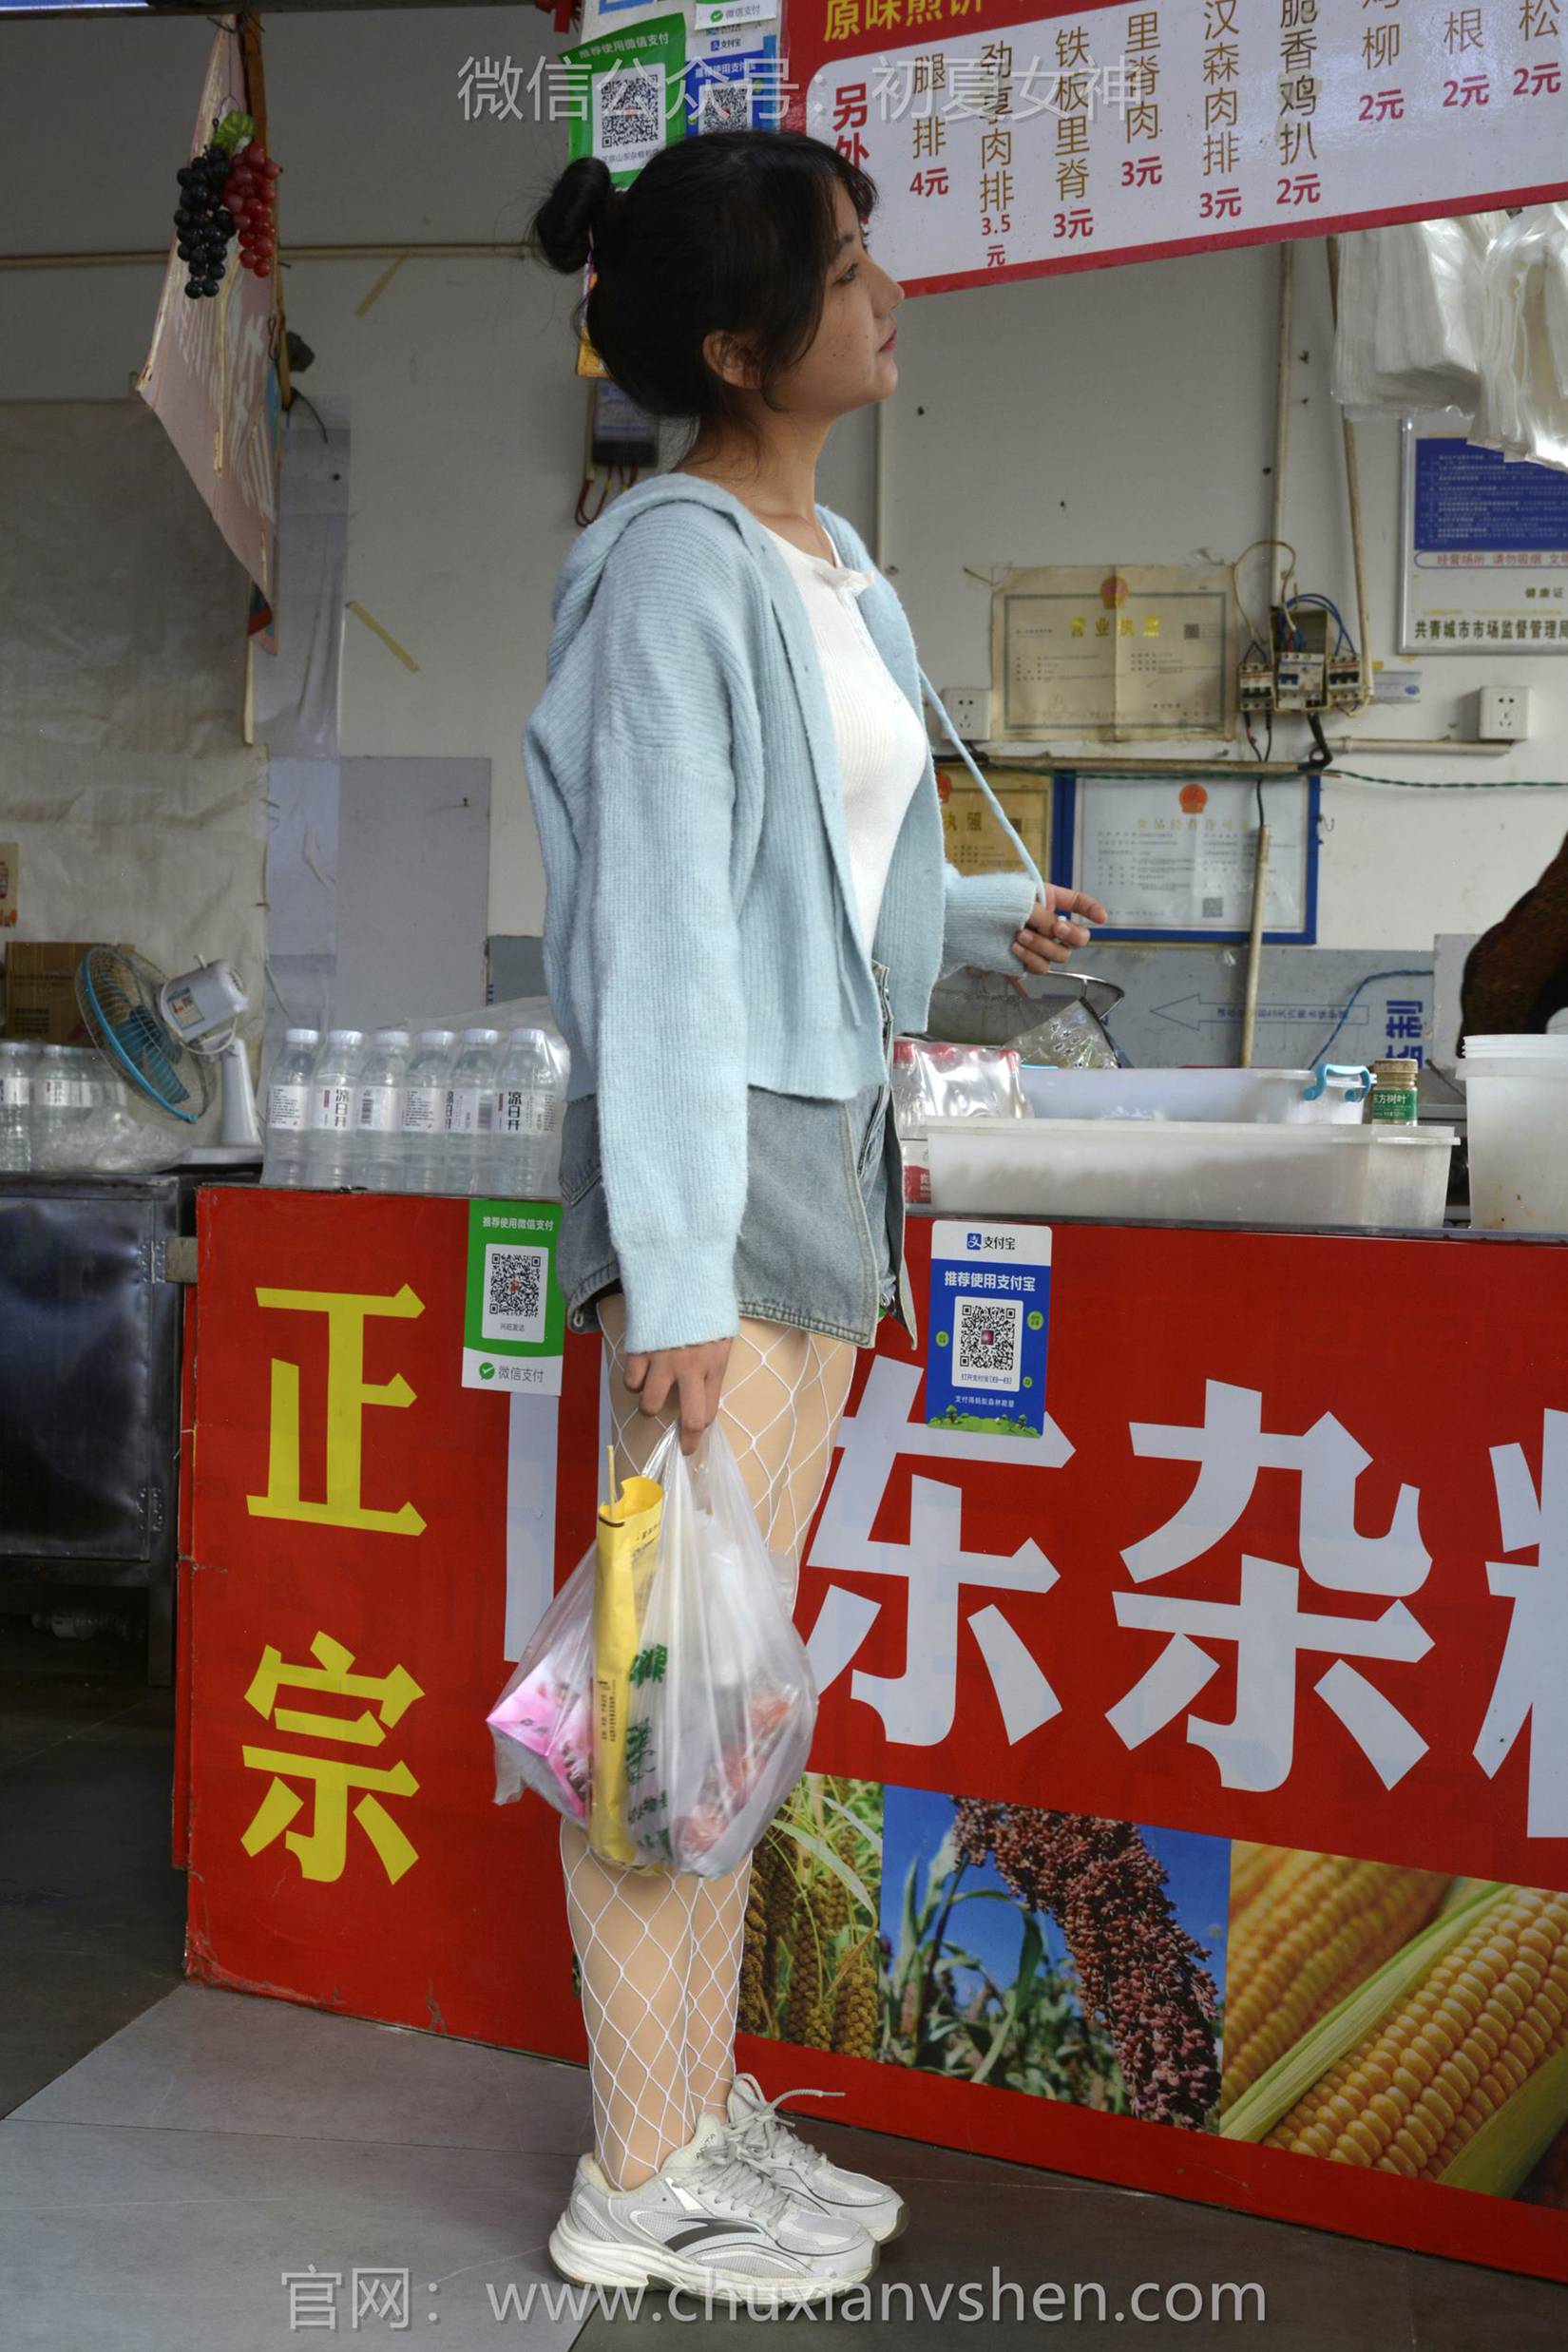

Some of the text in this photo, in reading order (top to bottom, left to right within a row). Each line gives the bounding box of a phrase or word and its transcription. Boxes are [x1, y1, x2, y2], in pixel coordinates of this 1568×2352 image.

[1361, 0, 1401, 70] 柳
[1444, 8, 1483, 55] 根
[1125, 11, 1160, 143] 里脊肉
[1442, 74, 1490, 108] 2元
[1513, 62, 1561, 96] 2元
[912, 53, 947, 159] 腿排
[1055, 26, 1090, 201] 铁板里脊
[1358, 88, 1405, 122] 2元
[909, 167, 949, 198] 4元
[1121, 156, 1162, 187] 3元
[1199, 187, 1242, 219] 3元
[1276, 173, 1321, 205] 2元
[1053, 208, 1094, 239] 3元
[483, 1216, 555, 1232] 推荐使用微信支付
[983, 1235, 1016, 1251] 支付宝
[944, 1271, 1036, 1291] 推荐使用支付宝
[498, 1366, 545, 1383] 微信支付
[240, 1282, 428, 1885] 正宗
